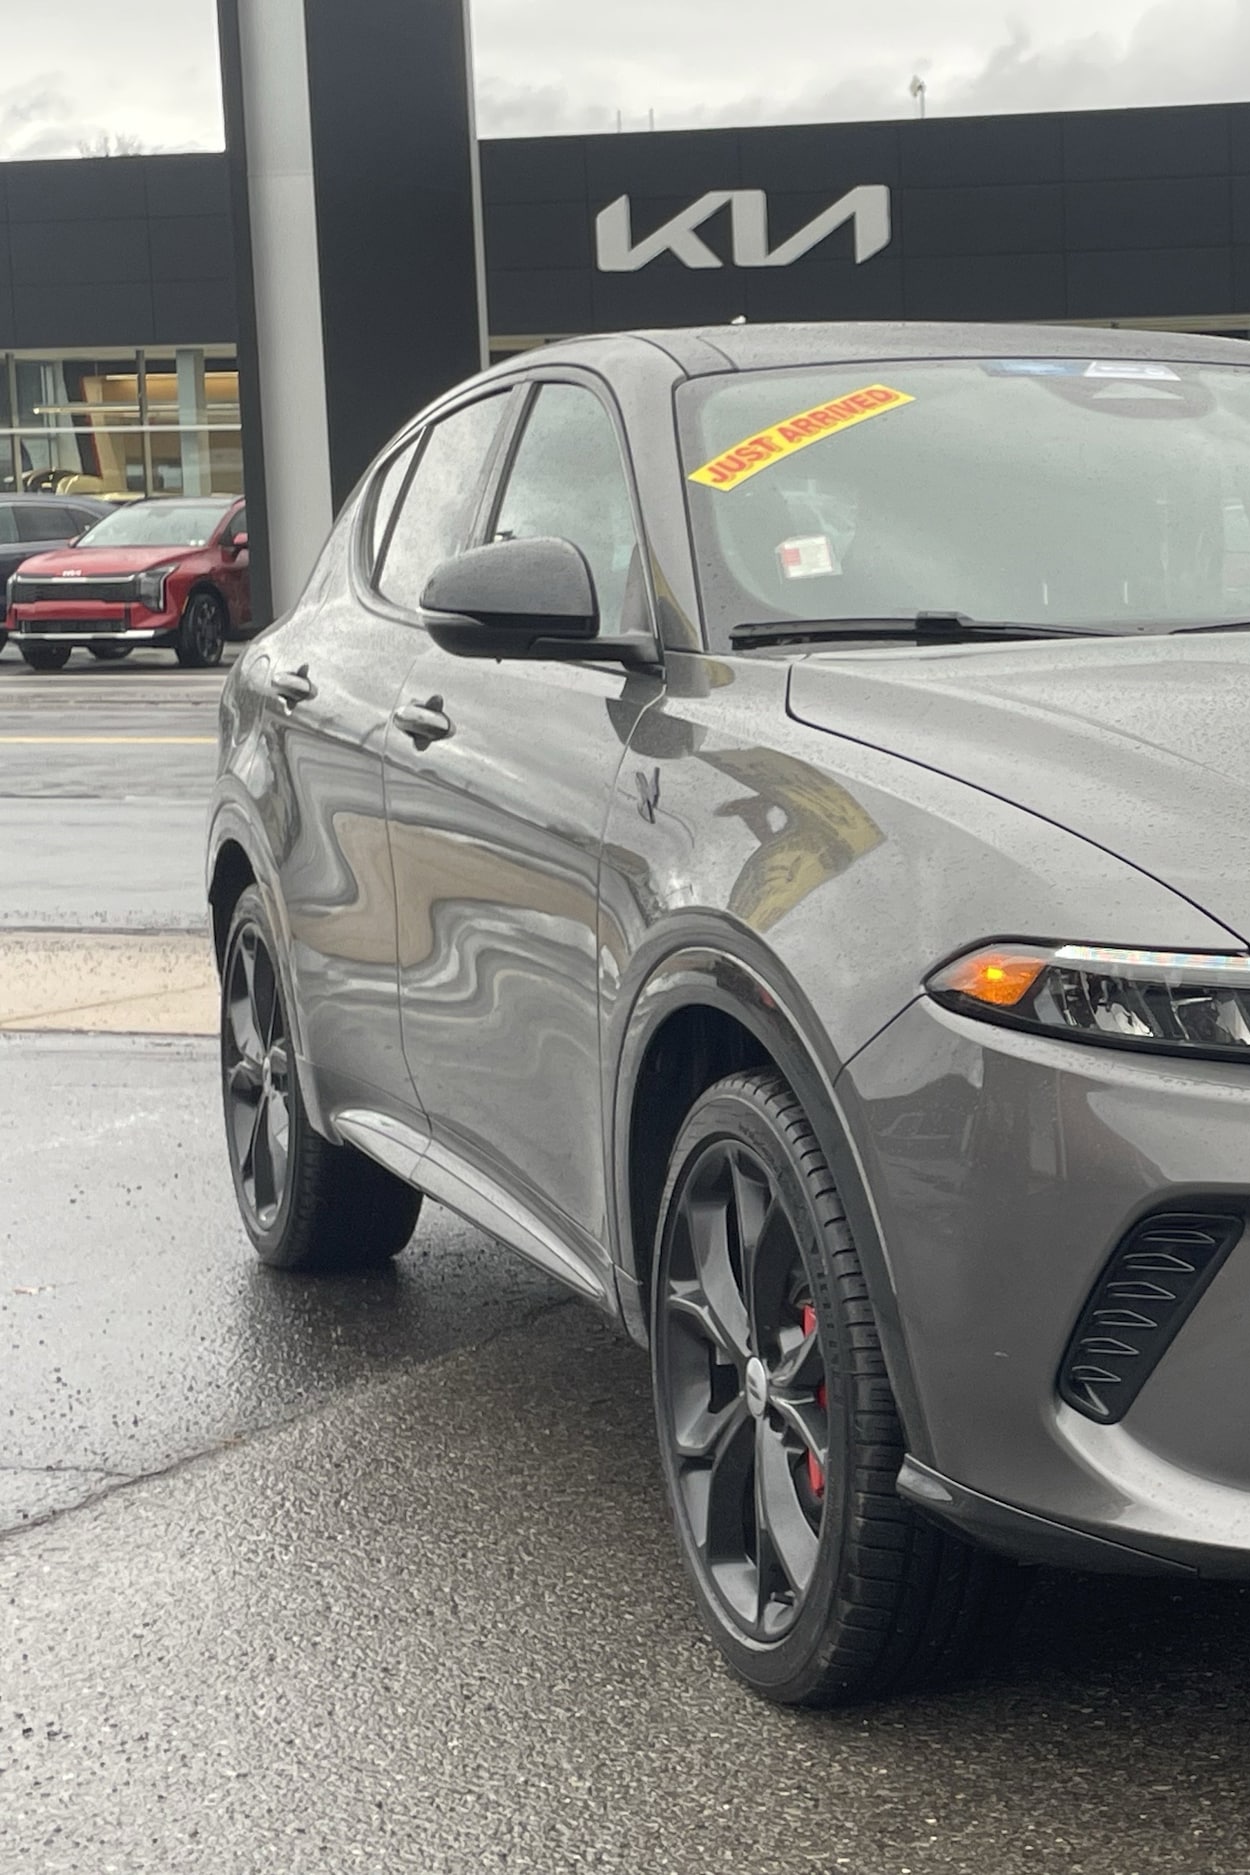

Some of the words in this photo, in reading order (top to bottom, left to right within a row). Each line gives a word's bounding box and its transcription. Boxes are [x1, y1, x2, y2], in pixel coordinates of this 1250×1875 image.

[595, 183, 892, 273] KIA
[706, 435, 783, 484] JUST
[775, 388, 900, 444] ARRIVED
